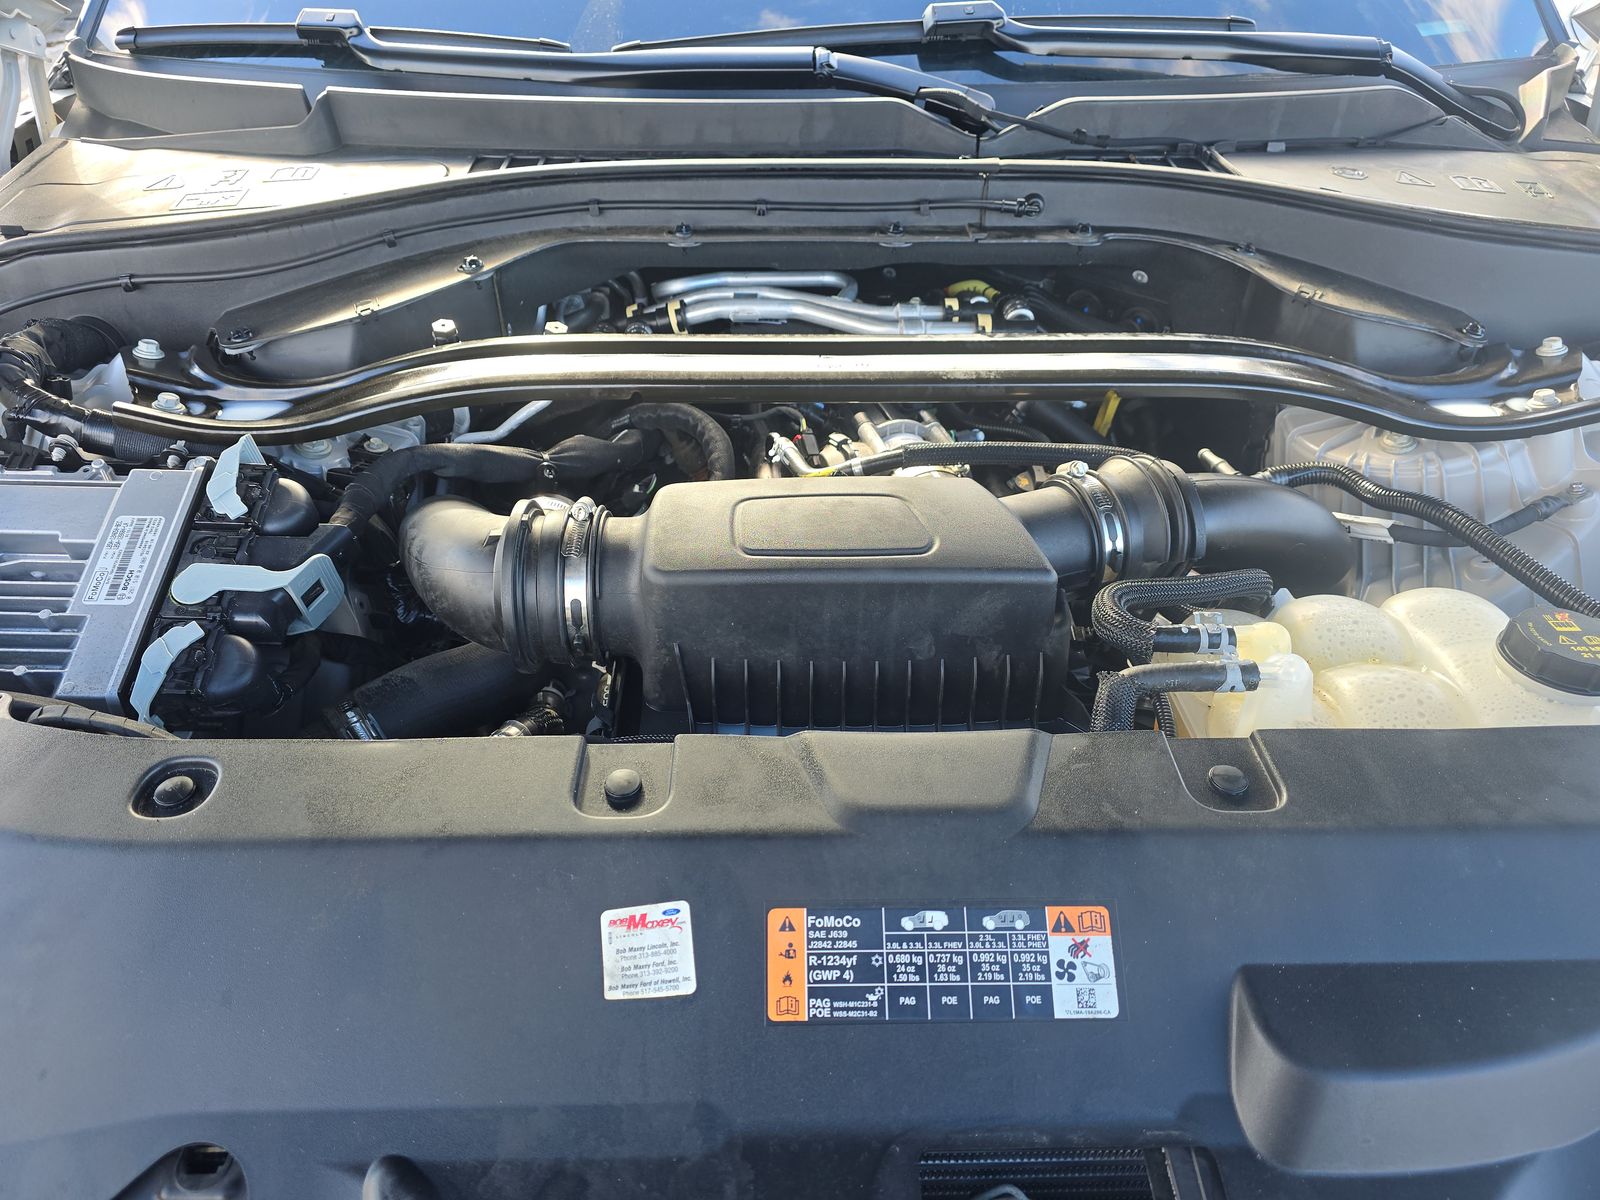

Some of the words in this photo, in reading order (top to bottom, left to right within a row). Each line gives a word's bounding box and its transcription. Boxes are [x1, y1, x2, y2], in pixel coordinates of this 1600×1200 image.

[121, 569, 135, 591] BOSCH
[87, 572, 106, 600] FoMoCo
[807, 916, 861, 928] FoMoCo
[809, 941, 832, 949] J2842
[834, 941, 857, 949] J2845
[809, 956, 857, 967] R-1234yf
[888, 955, 910, 963] 0.680
[911, 955, 922, 964] kg
[929, 954, 950, 963] 0.737
[952, 954, 963, 964] kg
[973, 954, 995, 962] 0.992
[996, 954, 1007, 964] kg
[1014, 953, 1036, 962] 0.992
[1037, 953, 1047, 963] kg
[809, 970, 841, 982] (GWP
[843, 970, 854, 981] 4)
[809, 999, 831, 1008] PAG
[900, 997, 916, 1005] PAG
[942, 996, 957, 1005] POE
[984, 996, 1000, 1004] PAG
[1026, 996, 1041, 1004] POE
[809, 1009, 831, 1017] POE
